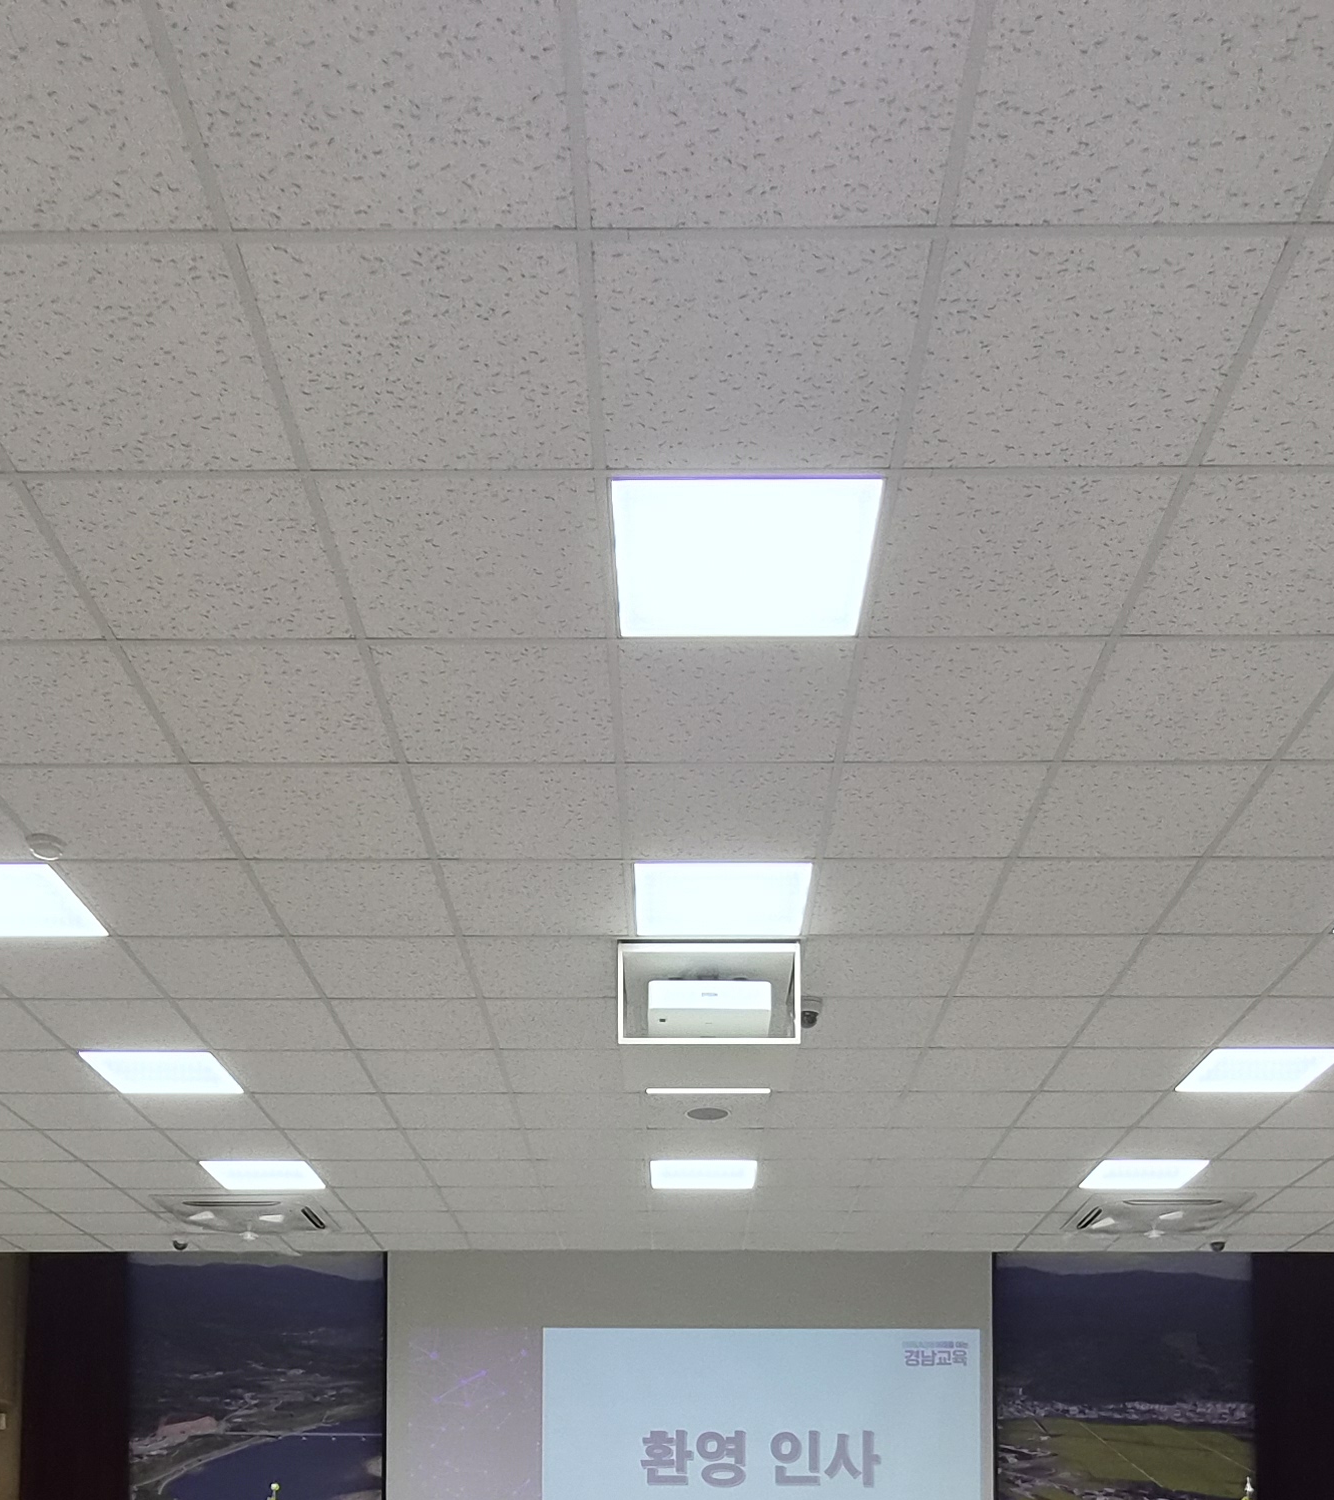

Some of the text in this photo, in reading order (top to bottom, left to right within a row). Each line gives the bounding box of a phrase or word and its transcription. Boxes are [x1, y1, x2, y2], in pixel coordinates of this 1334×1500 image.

[904, 1350, 968, 1367] 경남교육
[640, 1429, 882, 1488] 환영 인사
